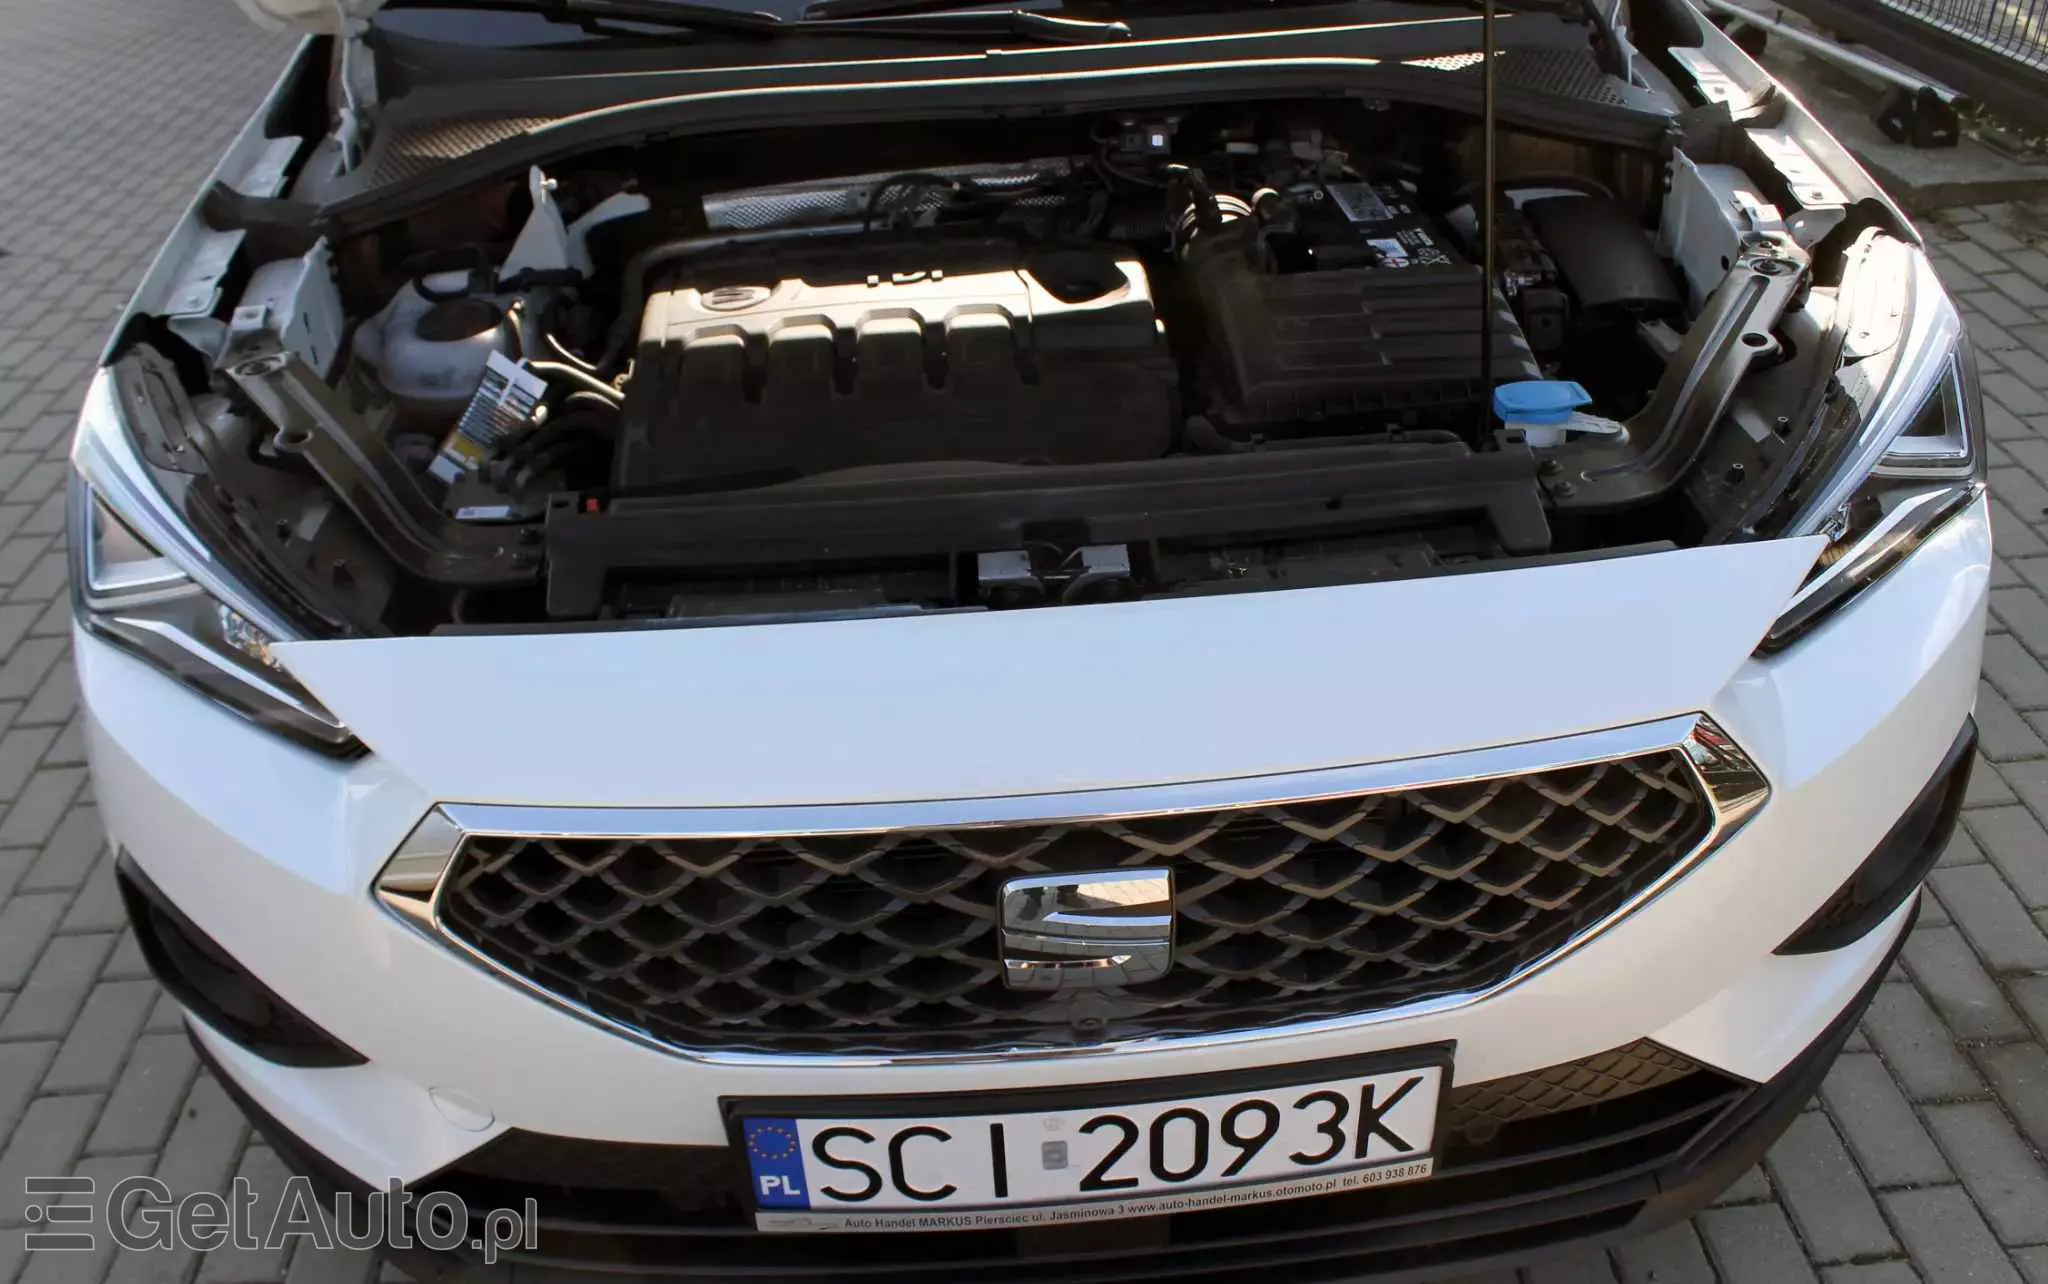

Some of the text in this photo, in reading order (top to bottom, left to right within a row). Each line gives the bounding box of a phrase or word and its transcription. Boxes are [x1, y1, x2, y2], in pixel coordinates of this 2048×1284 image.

[1079, 1076, 1424, 1191] 2093K
[760, 1175, 800, 1196] PL
[845, 1217, 871, 1229] Auto
[875, 1216, 916, 1228] Handel
[918, 1214, 972, 1228] MARKUS
[1032, 1211, 1045, 1222] ul.
[1050, 1206, 1114, 1221] Jasminowa
[1117, 1204, 1125, 1216] 3
[1343, 1174, 1360, 1186] tel.
[1362, 1171, 1383, 1184] 603
[1385, 1168, 1406, 1180] 938
[1407, 1164, 1427, 1176] 876
